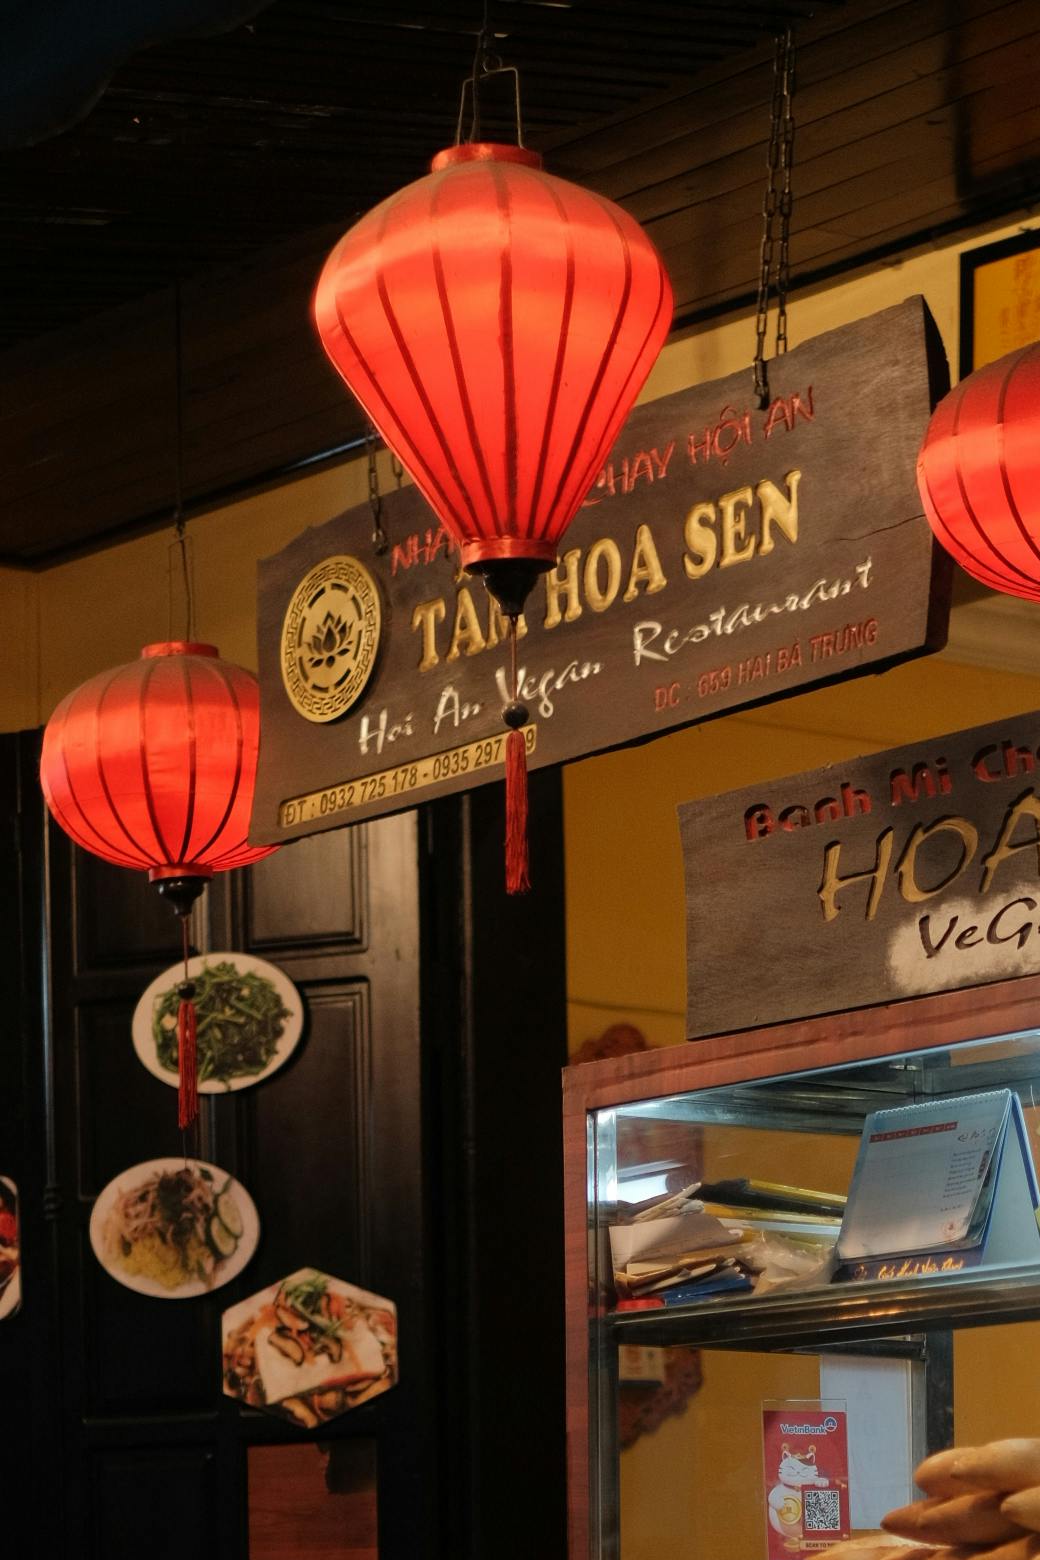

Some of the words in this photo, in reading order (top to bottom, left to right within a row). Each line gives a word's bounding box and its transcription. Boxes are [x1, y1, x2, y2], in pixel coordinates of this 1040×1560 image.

[687, 404, 752, 467] HỘI
[764, 384, 815, 440] AN
[543, 523, 668, 629] HOA
[683, 468, 802, 580] SEN
[433, 685, 482, 735] An
[495, 660, 604, 719] Vegan
[632, 556, 873, 667] Restaurant
[698, 665, 733, 698] 659
[736, 653, 771, 686] HAI
[318, 785, 356, 815] 0932
[360, 774, 387, 800] 725
[391, 765, 418, 794] 178
[432, 752, 470, 781] 0935
[473, 737, 504, 769] 297
[888, 756, 952, 806] Mi
